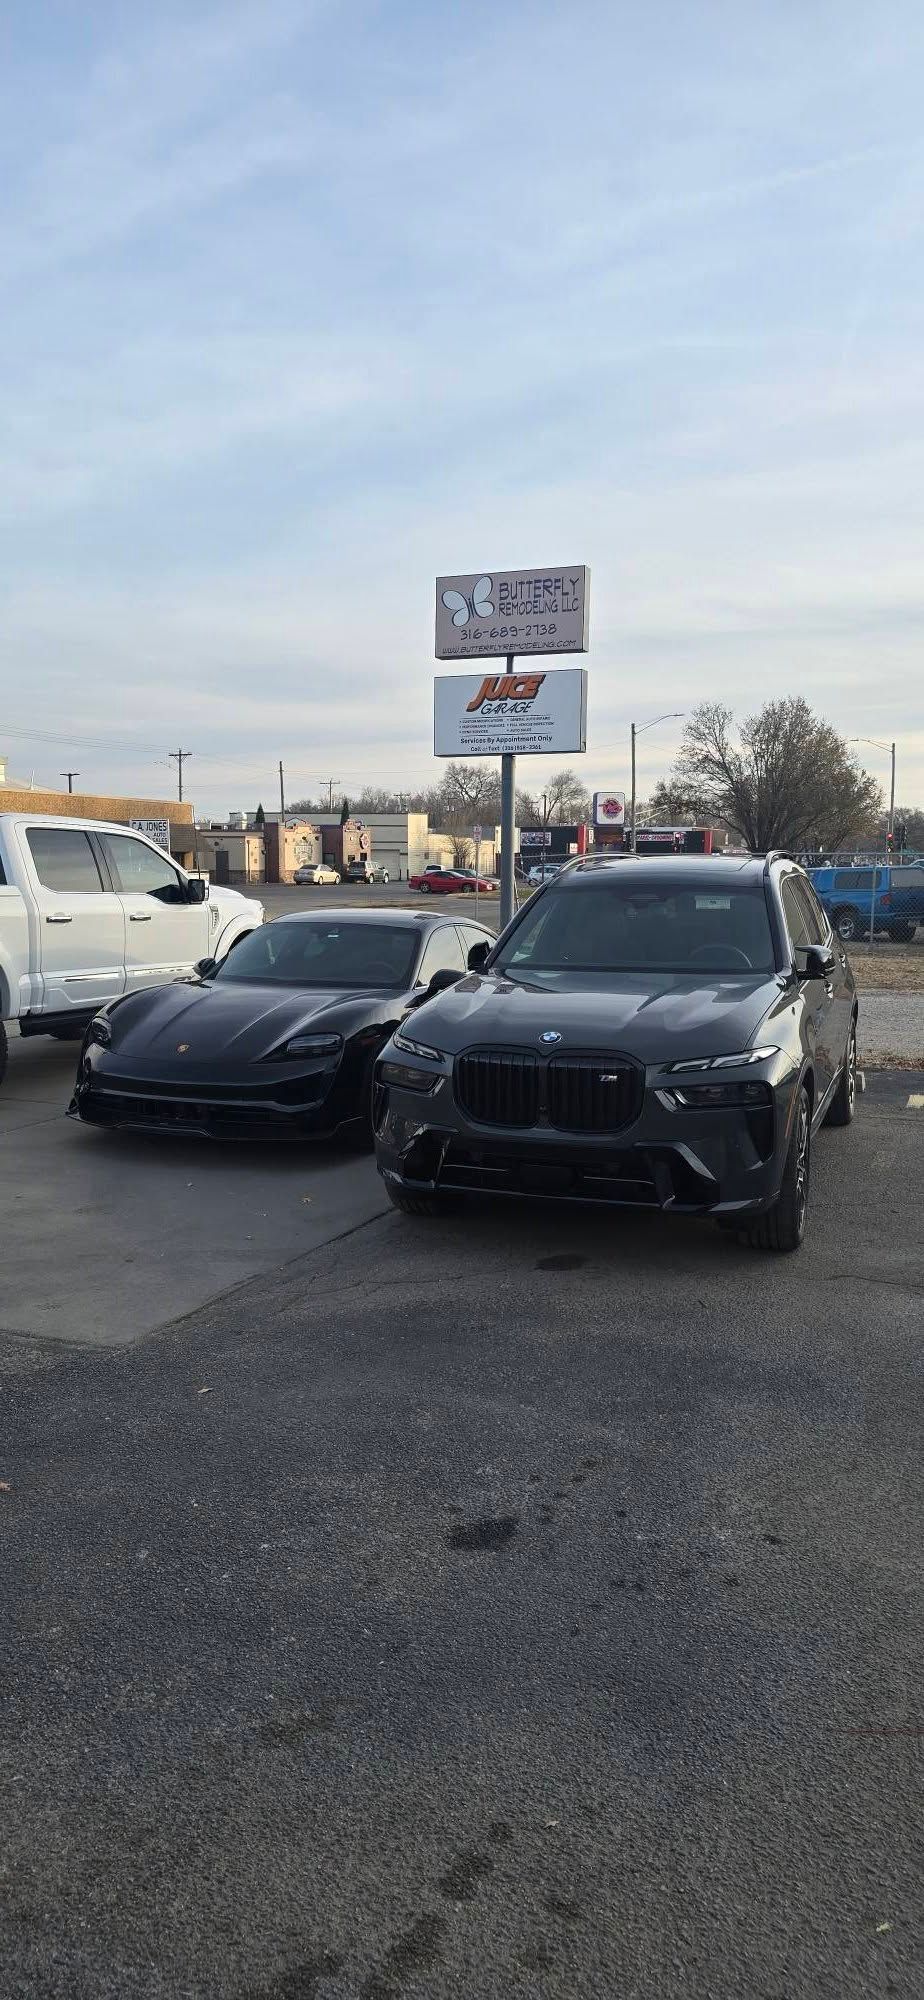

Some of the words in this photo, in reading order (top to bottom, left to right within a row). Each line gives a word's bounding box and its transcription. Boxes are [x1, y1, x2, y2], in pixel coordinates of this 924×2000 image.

[499, 576, 579, 601] BUTTERFLY
[561, 597, 579, 613] LLC
[460, 623, 558, 641] 316-689-2738
[466, 674, 546, 712] JUICE
[481, 701, 534, 714] GARAGE
[487, 737, 495, 745] By
[495, 735, 537, 744] Appointment
[537, 734, 553, 742] Only
[146, 821, 167, 831] JONES
